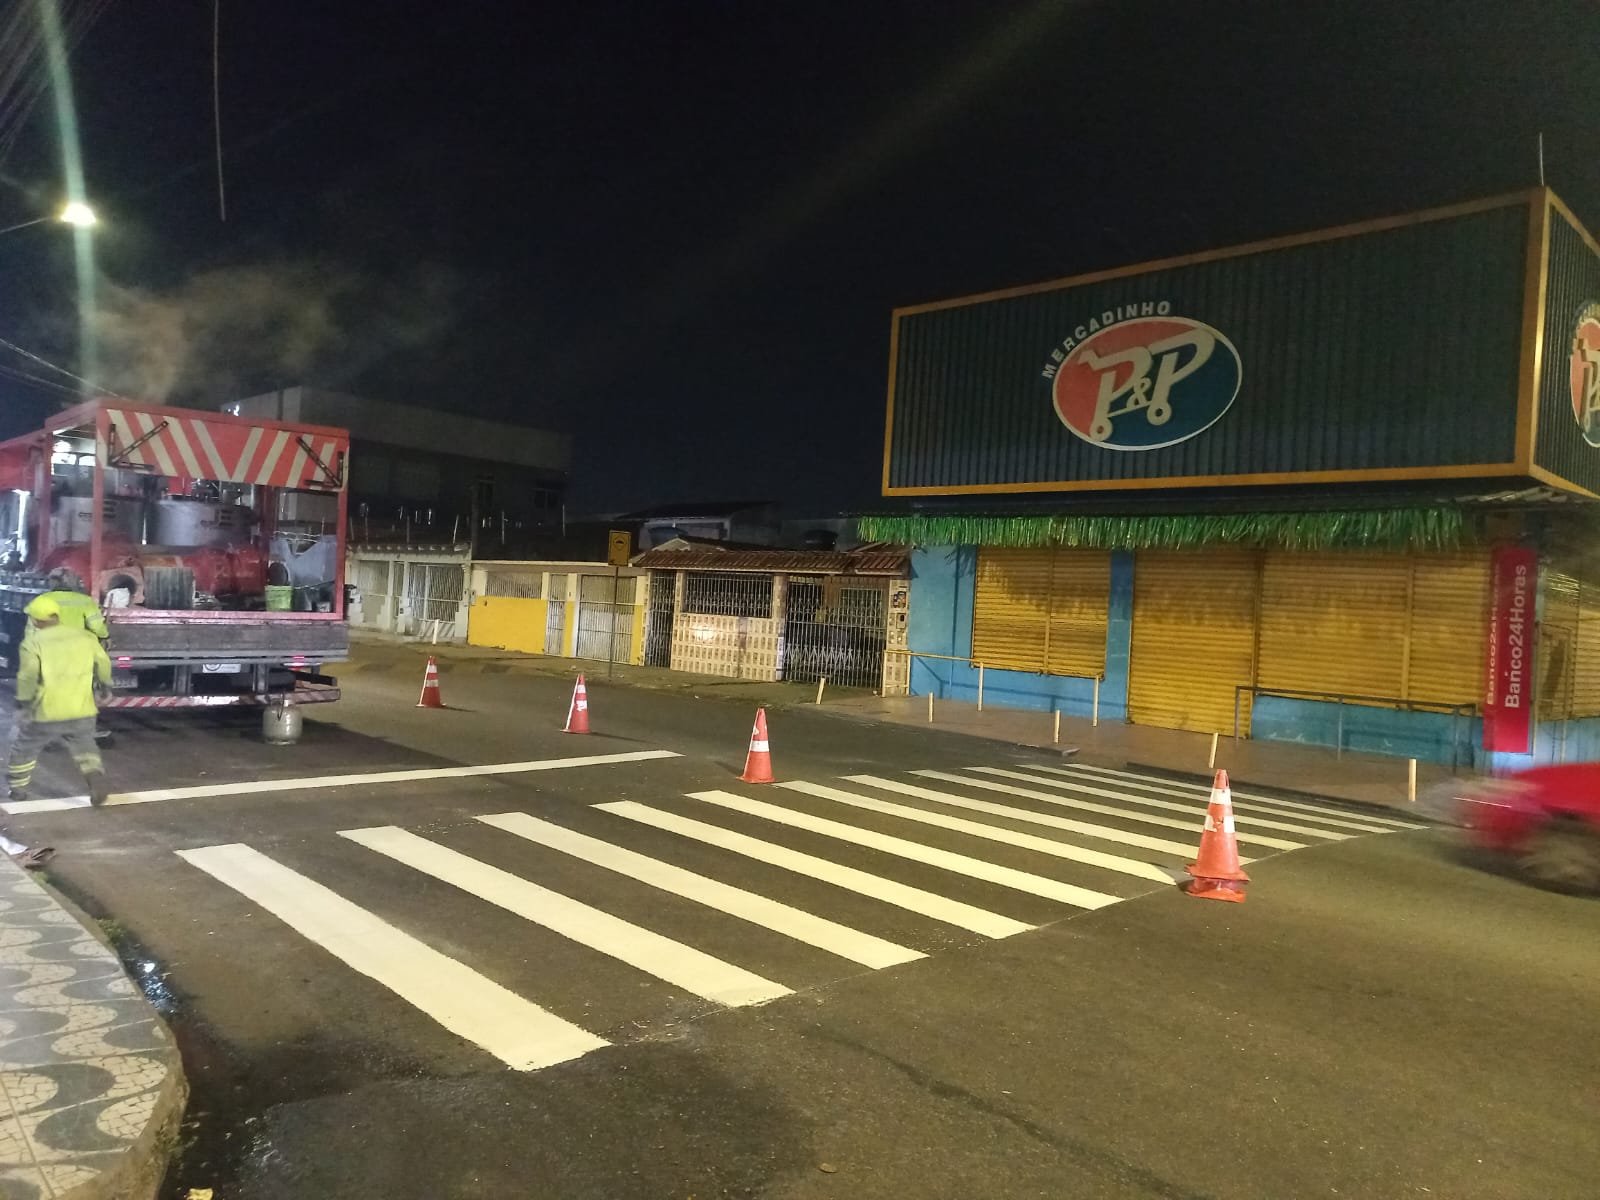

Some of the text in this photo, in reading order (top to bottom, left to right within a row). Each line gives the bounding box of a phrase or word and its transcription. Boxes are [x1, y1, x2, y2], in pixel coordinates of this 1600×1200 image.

[1041, 300, 1171, 379] MERCADINHO
[1078, 328, 1216, 442] P&P
[1486, 562, 1500, 705] Banco24H
[1504, 564, 1527, 708] Banco24Horas
